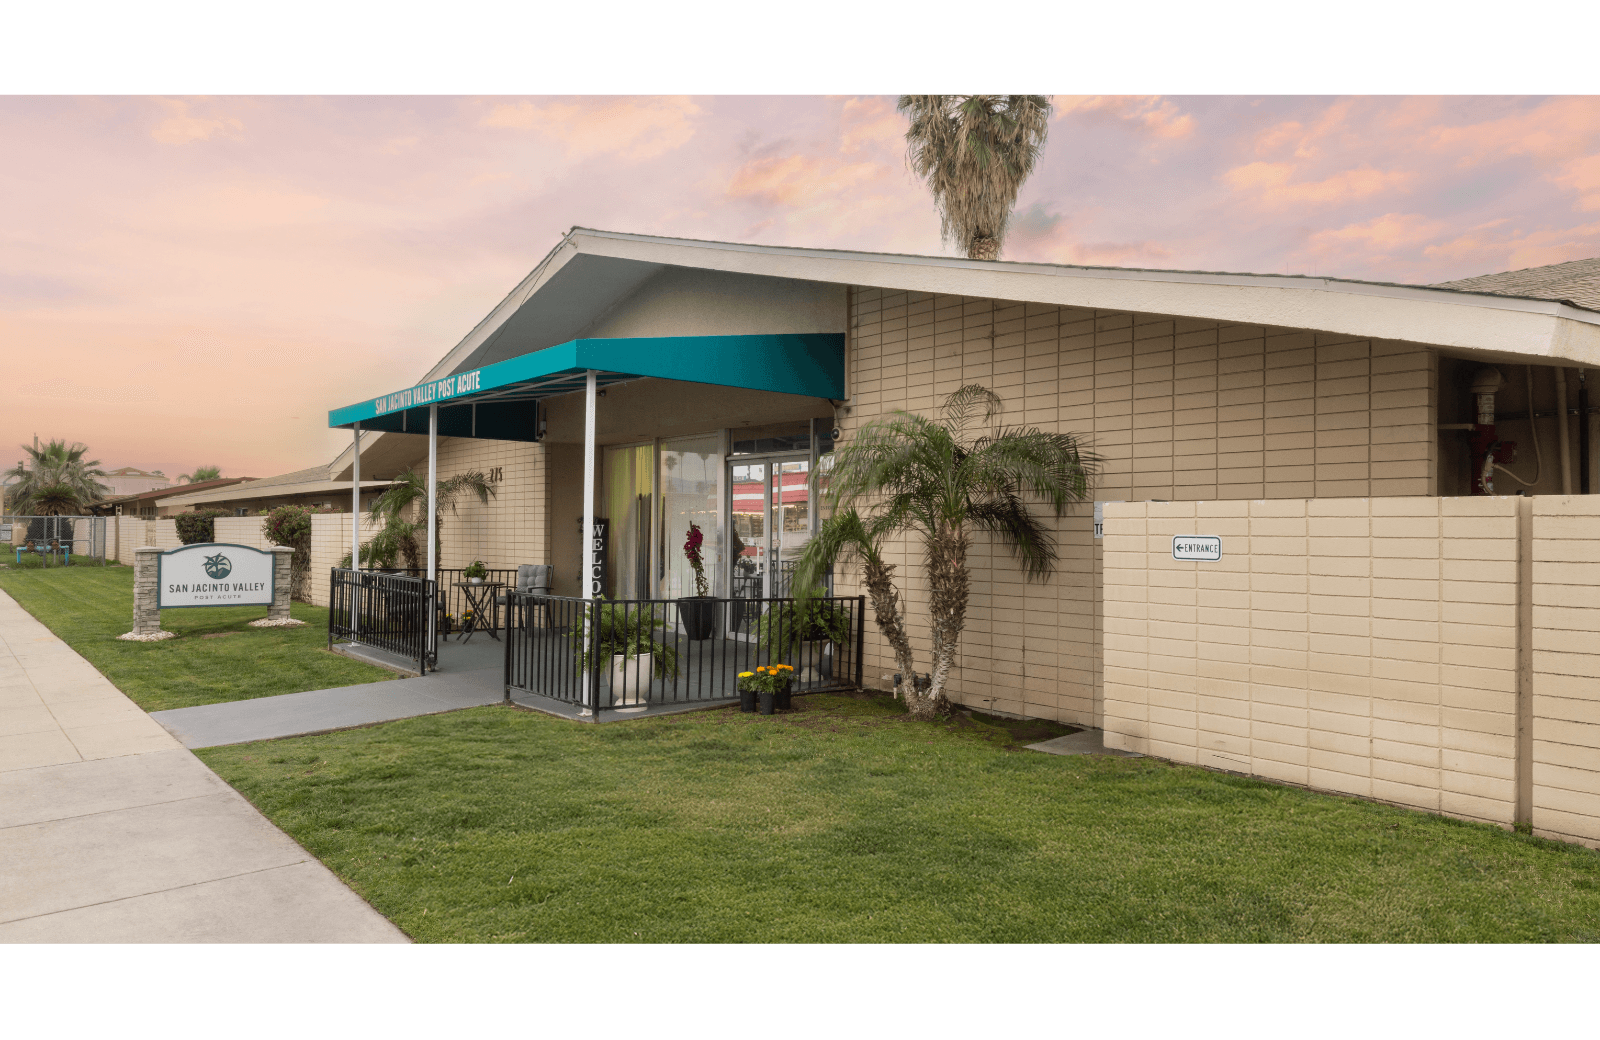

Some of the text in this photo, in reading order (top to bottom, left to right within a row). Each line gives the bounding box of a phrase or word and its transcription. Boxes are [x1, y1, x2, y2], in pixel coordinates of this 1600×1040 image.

[375, 370, 481, 414] SAN JACINTO VALLEY POST ACUTE
[1184, 544, 1218, 553] ENTRANCE
[169, 582, 265, 593] SAN JACINTO VALLEY
